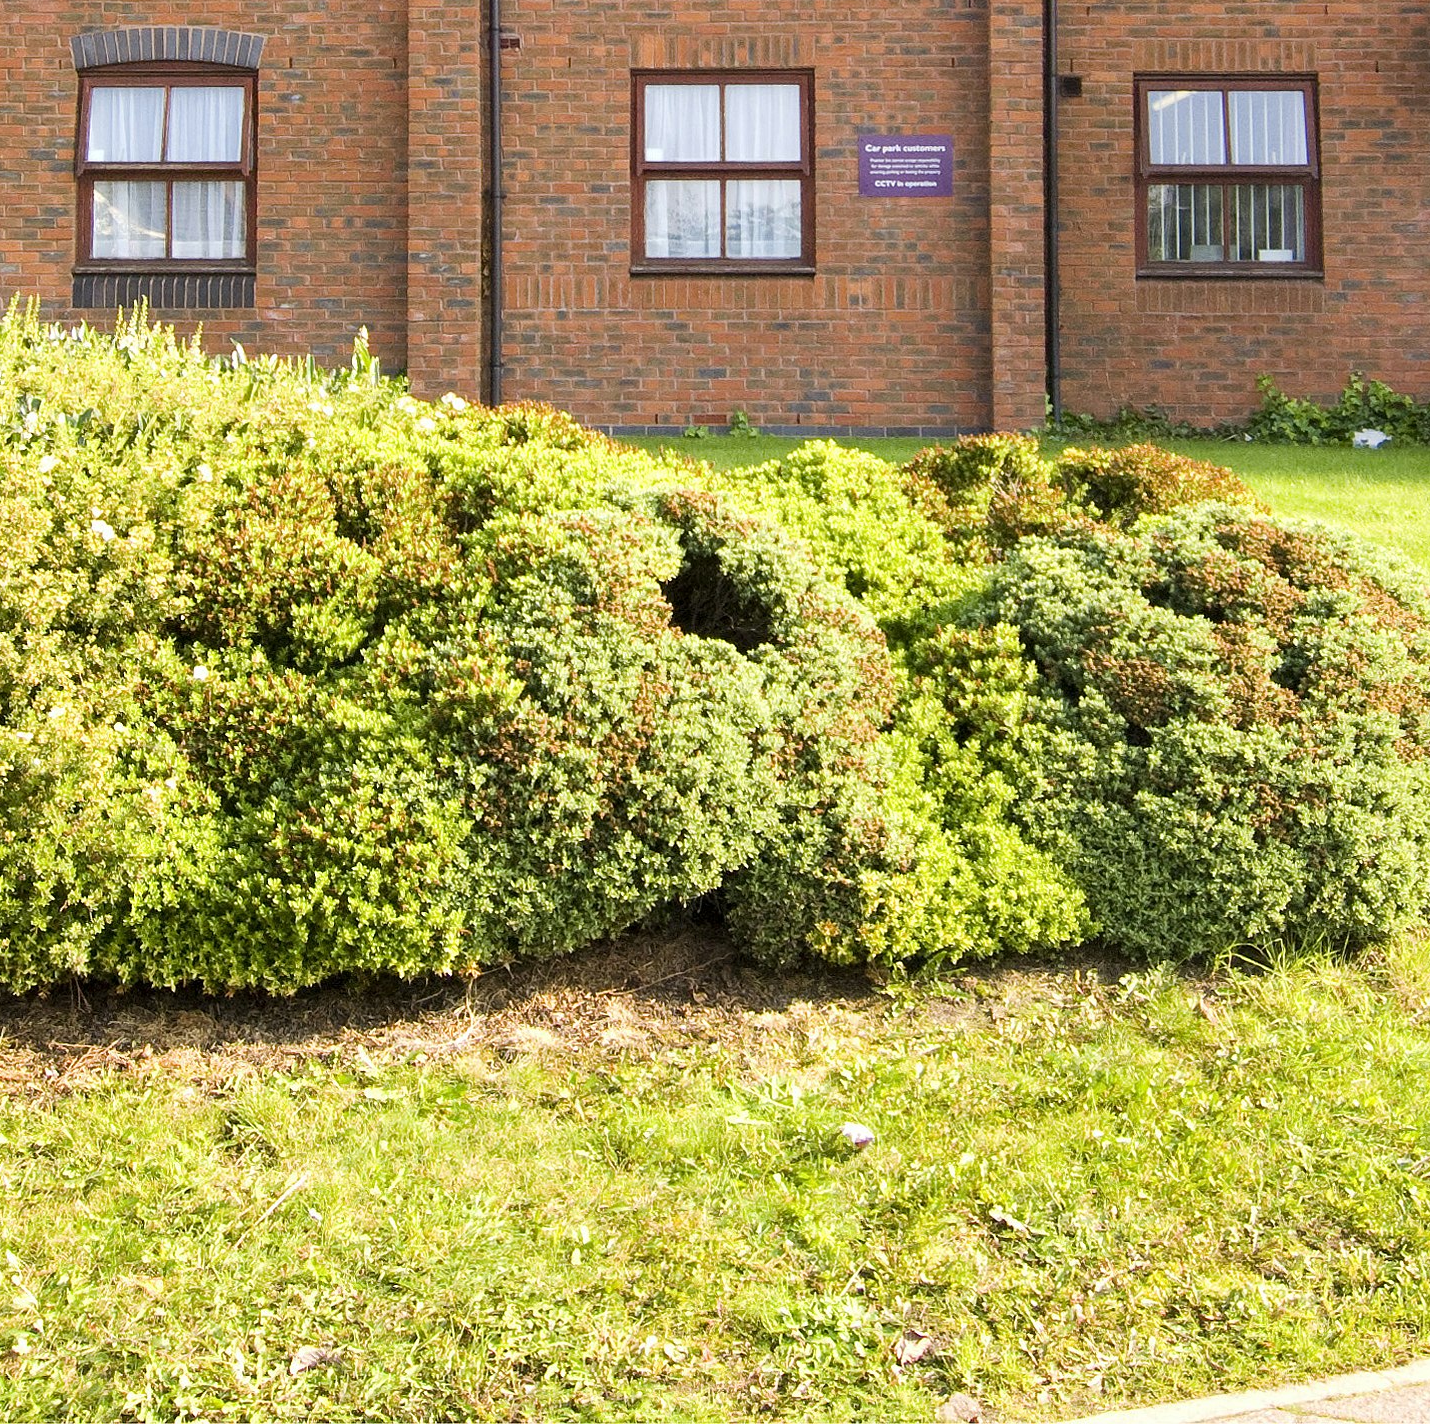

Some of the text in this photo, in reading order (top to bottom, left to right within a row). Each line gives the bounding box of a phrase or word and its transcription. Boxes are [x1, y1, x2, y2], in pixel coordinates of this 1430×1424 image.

[865, 144, 946, 154] Car park customers
[904, 180, 937, 188] operation
